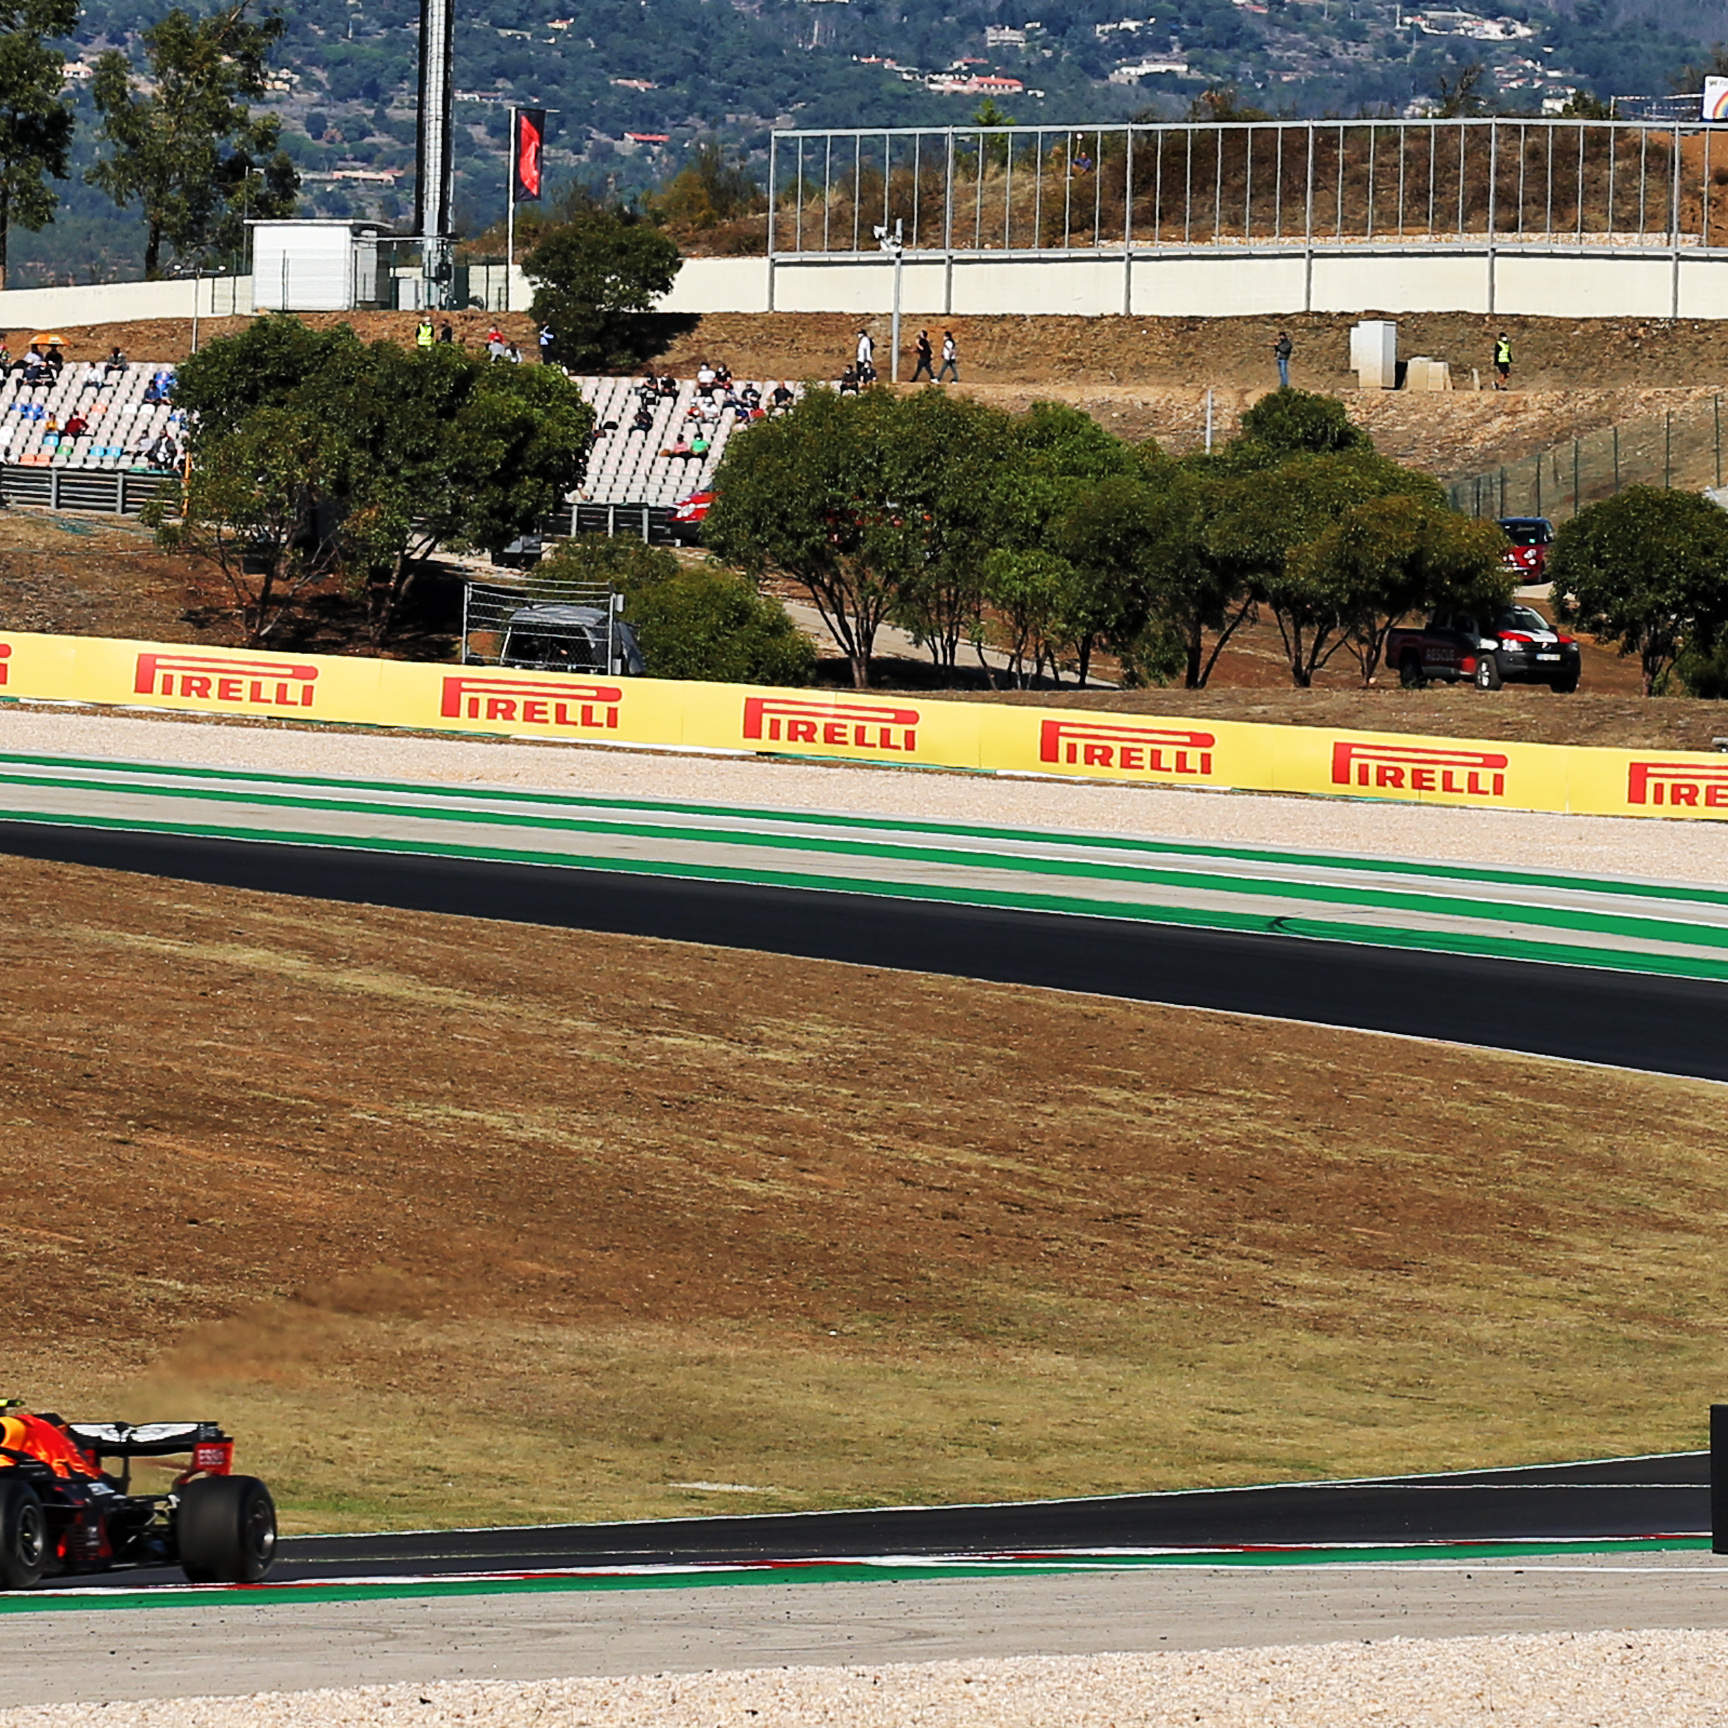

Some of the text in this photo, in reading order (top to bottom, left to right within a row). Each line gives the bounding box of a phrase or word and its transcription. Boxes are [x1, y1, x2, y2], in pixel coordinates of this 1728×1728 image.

[134, 653, 319, 707] PIRELLI
[440, 676, 623, 729] PIRELLI
[742, 697, 920, 752] PIRELLI
[1039, 719, 1216, 775] PIRELLI
[1331, 741, 1509, 796] PIRELLI
